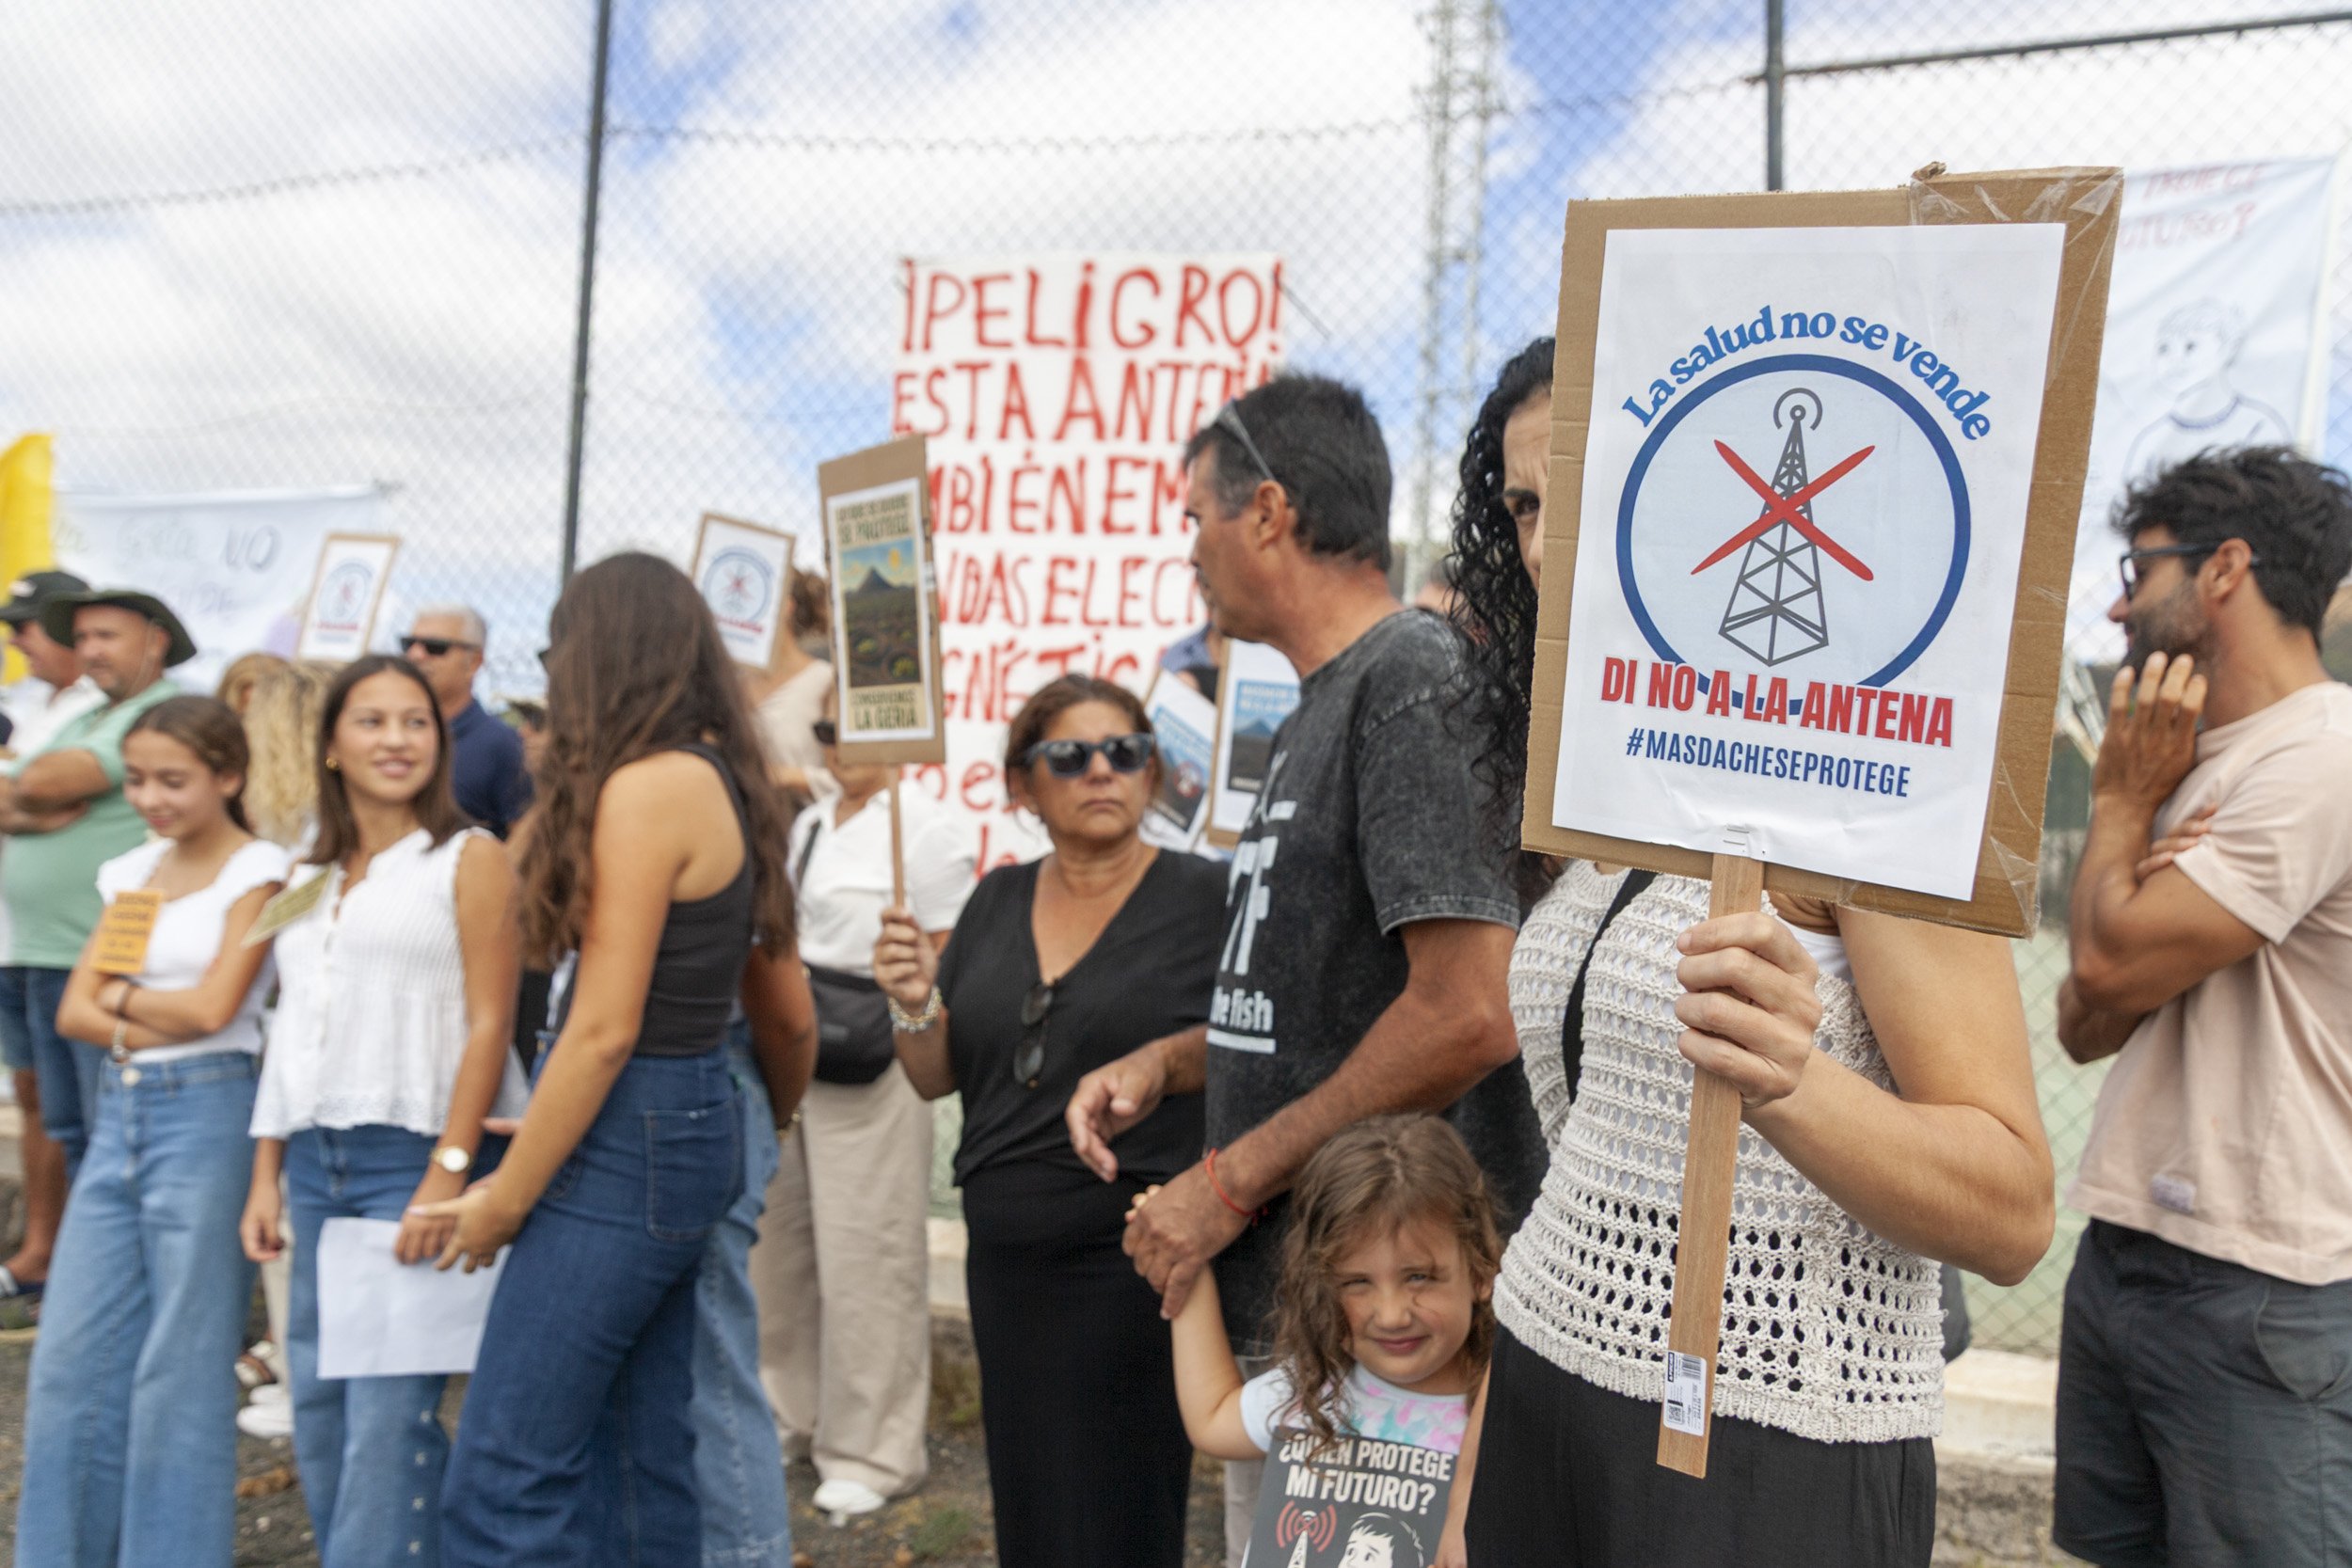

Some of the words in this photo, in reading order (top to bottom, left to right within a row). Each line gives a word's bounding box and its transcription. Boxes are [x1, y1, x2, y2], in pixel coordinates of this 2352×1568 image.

[893, 358, 1036, 441] ESTA
[1622, 378, 1676, 427] La
[1670, 305, 1776, 385] salud
[1780, 311, 1836, 339] no
[1839, 316, 1889, 351] se
[1892, 331, 1992, 440] vende
[1601, 657, 1638, 705] DI
[1647, 661, 1697, 712] NO
[1706, 670, 1731, 717] A
[1743, 673, 1788, 724] LA
[1800, 681, 1954, 748] ANTENA
[1626, 727, 1911, 798] #MASDACHESEPROTEGE
[1320, 1469, 1438, 1515] FUTURO?
[1356, 1439, 1454, 1482] PROTEGE
